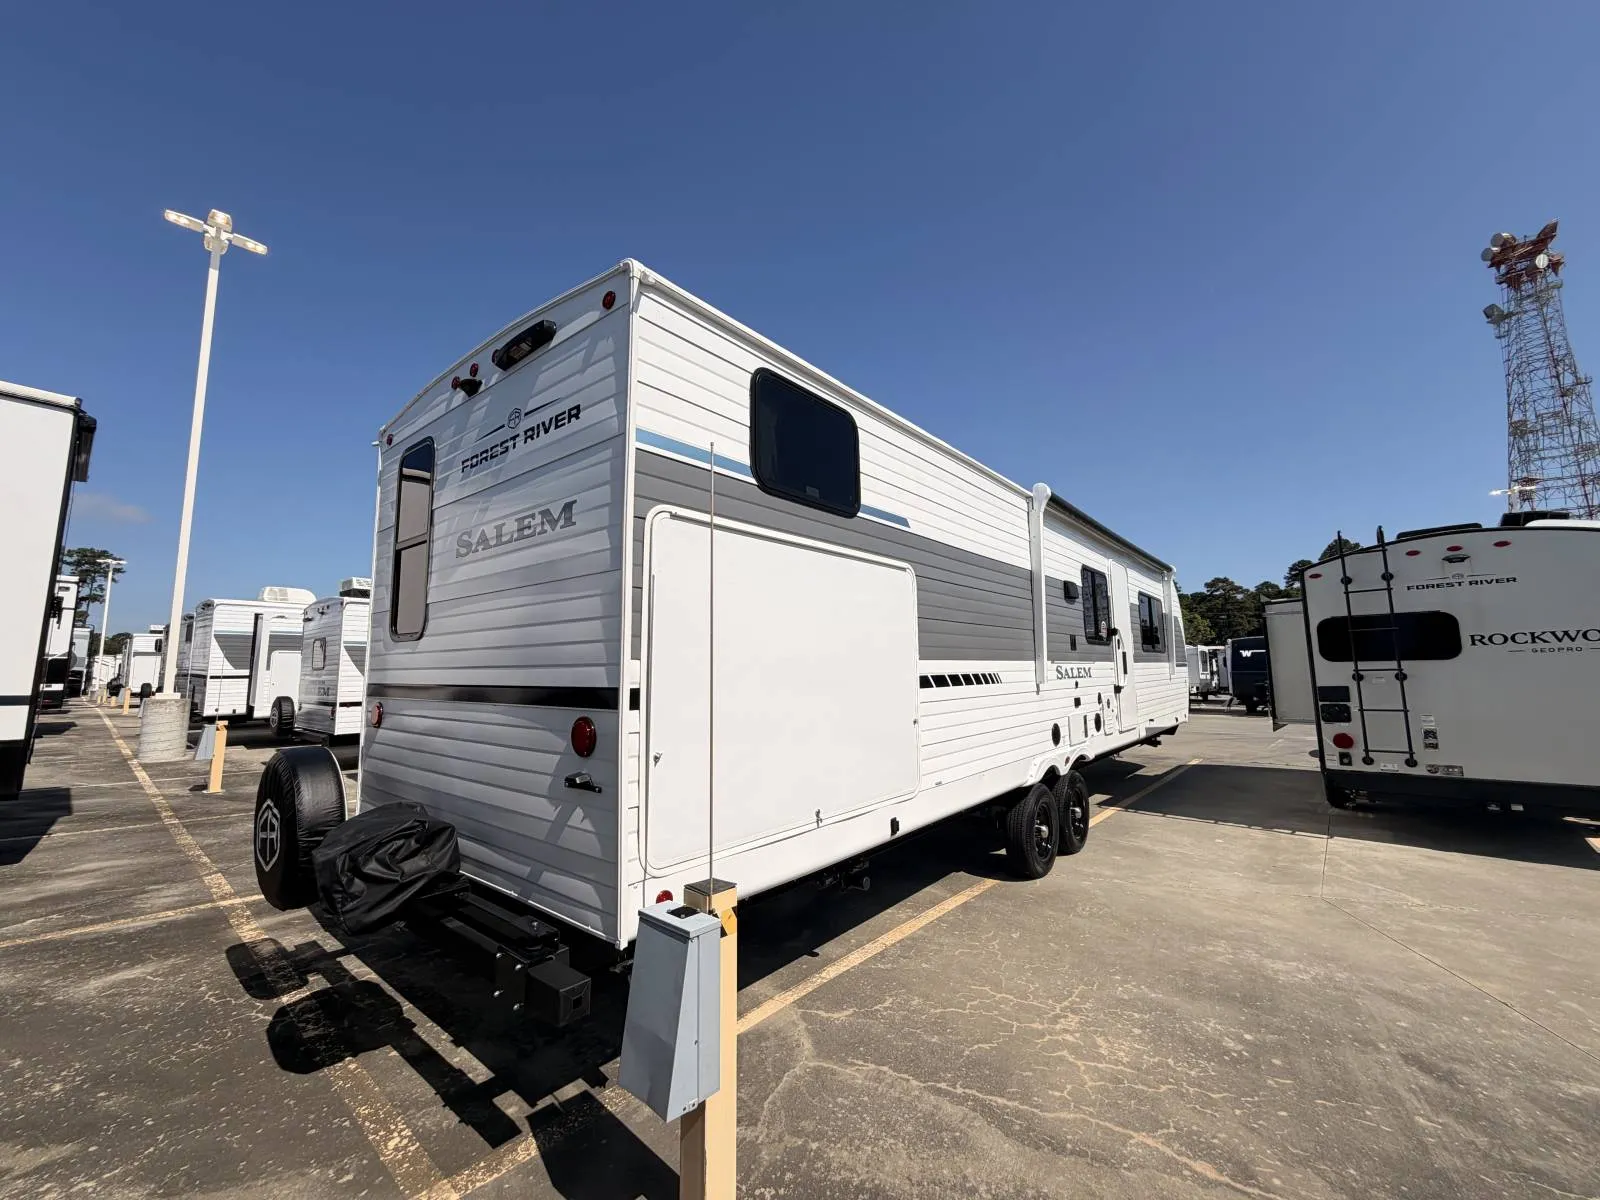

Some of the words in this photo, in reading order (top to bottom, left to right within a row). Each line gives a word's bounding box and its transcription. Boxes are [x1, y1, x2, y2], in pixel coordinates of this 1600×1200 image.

[461, 433, 520, 473] FOREST
[523, 404, 581, 444] RIVER
[456, 499, 578, 558] SALEM
[1407, 581, 1465, 591] FOREST
[1468, 577, 1518, 586] RIVER
[1469, 629, 1600, 646] ROCKWO
[1056, 665, 1092, 680] SALEM
